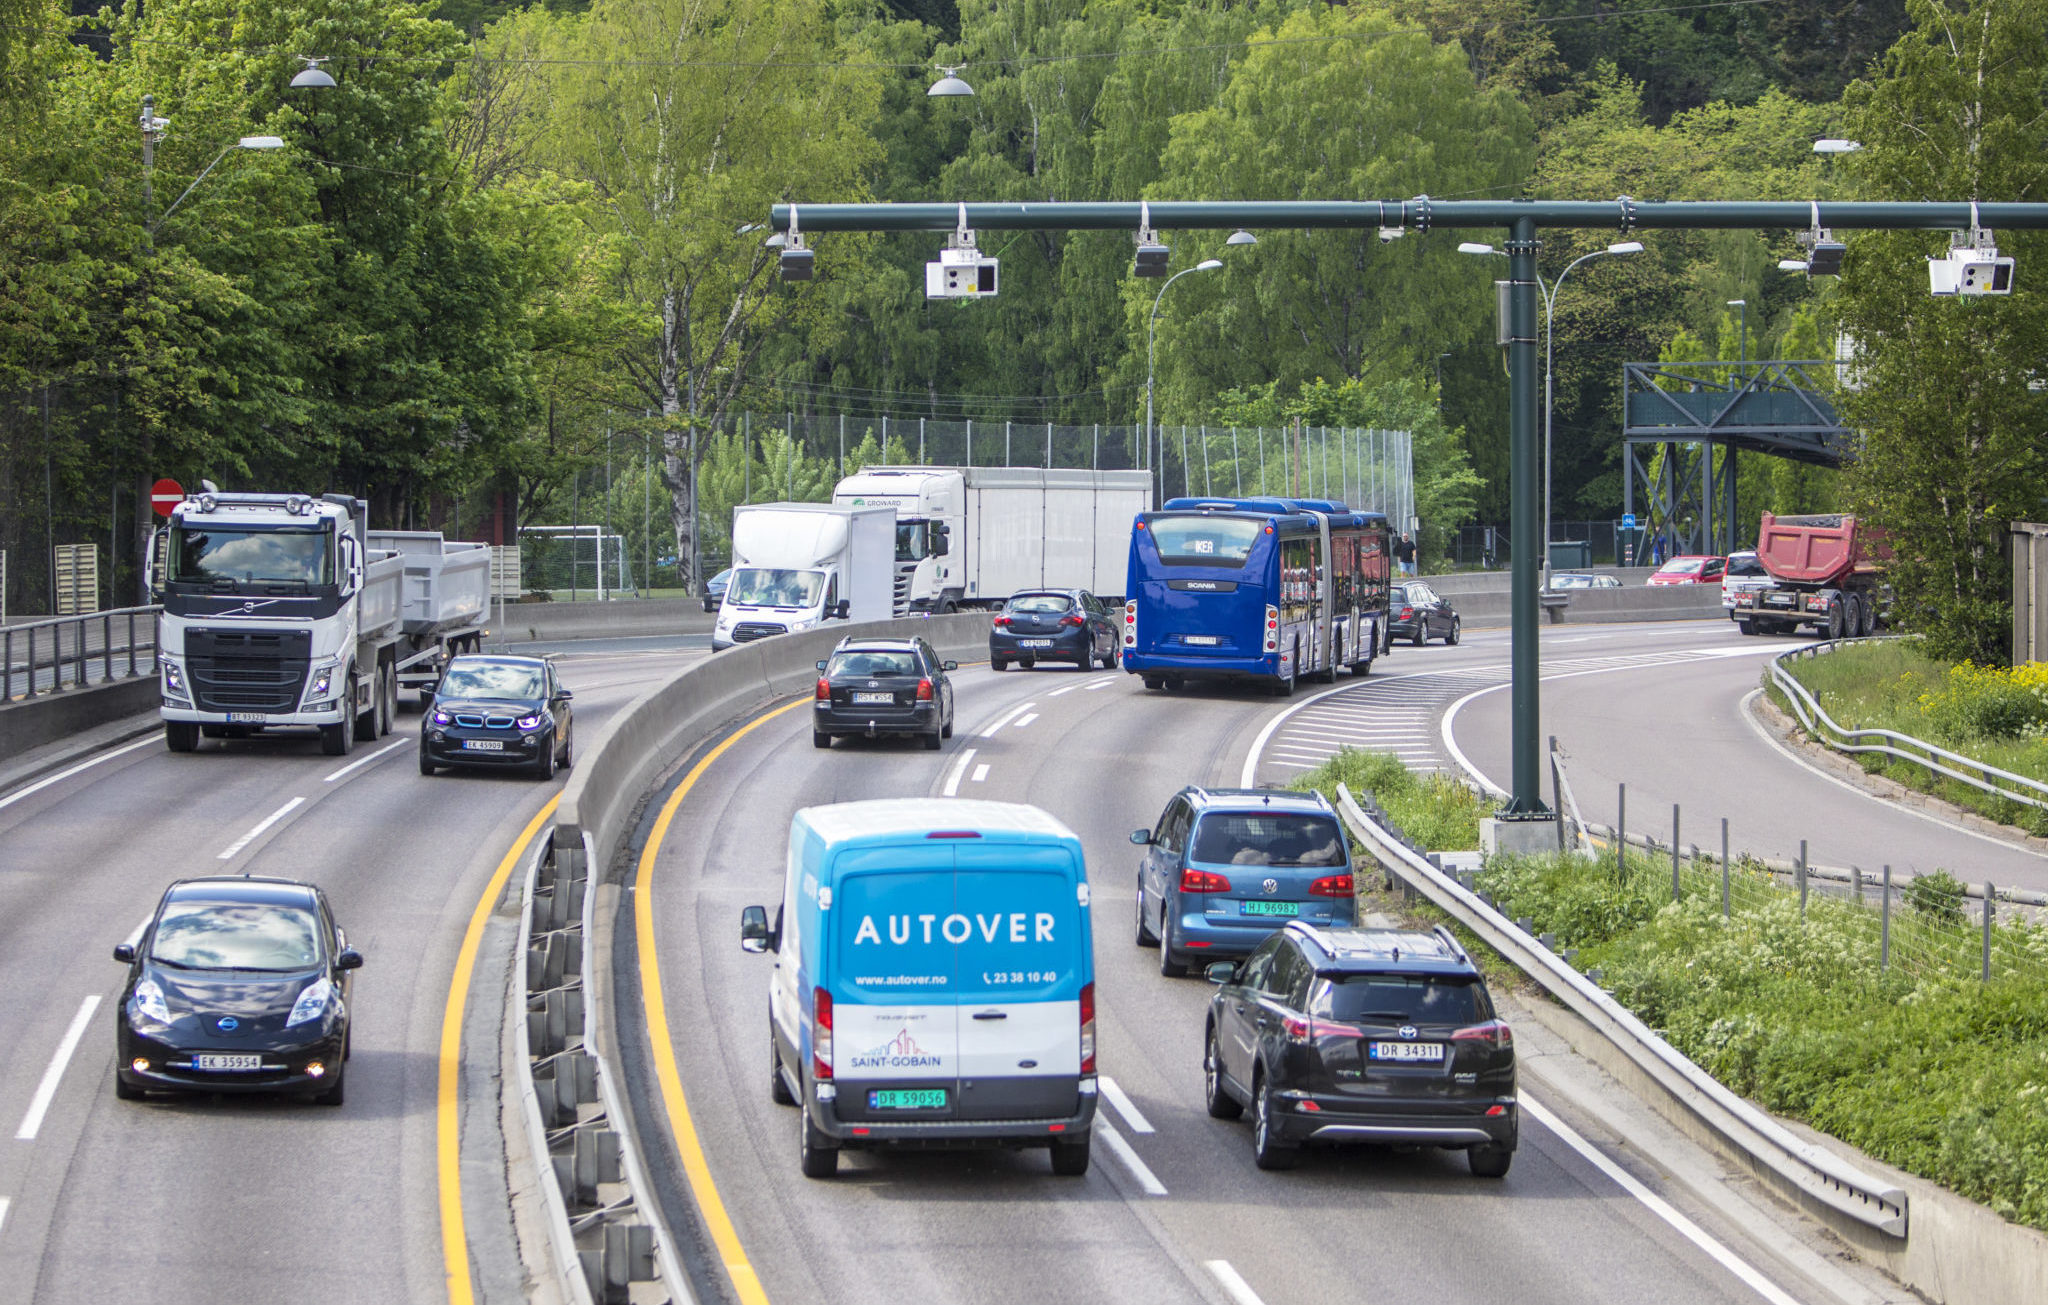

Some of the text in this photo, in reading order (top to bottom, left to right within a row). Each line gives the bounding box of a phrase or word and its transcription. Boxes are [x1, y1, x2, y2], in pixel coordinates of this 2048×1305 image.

[1195, 540, 1214, 553] IKEA
[1248, 902, 1296, 914] HJ 96982
[854, 912, 1055, 945] AUTOVER
[855, 974, 948, 985] www.autover.no
[993, 971, 1057, 984] 23 38 10 40
[1381, 1043, 1439, 1057] DR 34311
[201, 1056, 258, 1068] EK 35954
[851, 1056, 942, 1068] SAINT-GOBAIN
[879, 1091, 943, 1105] DR 59056
